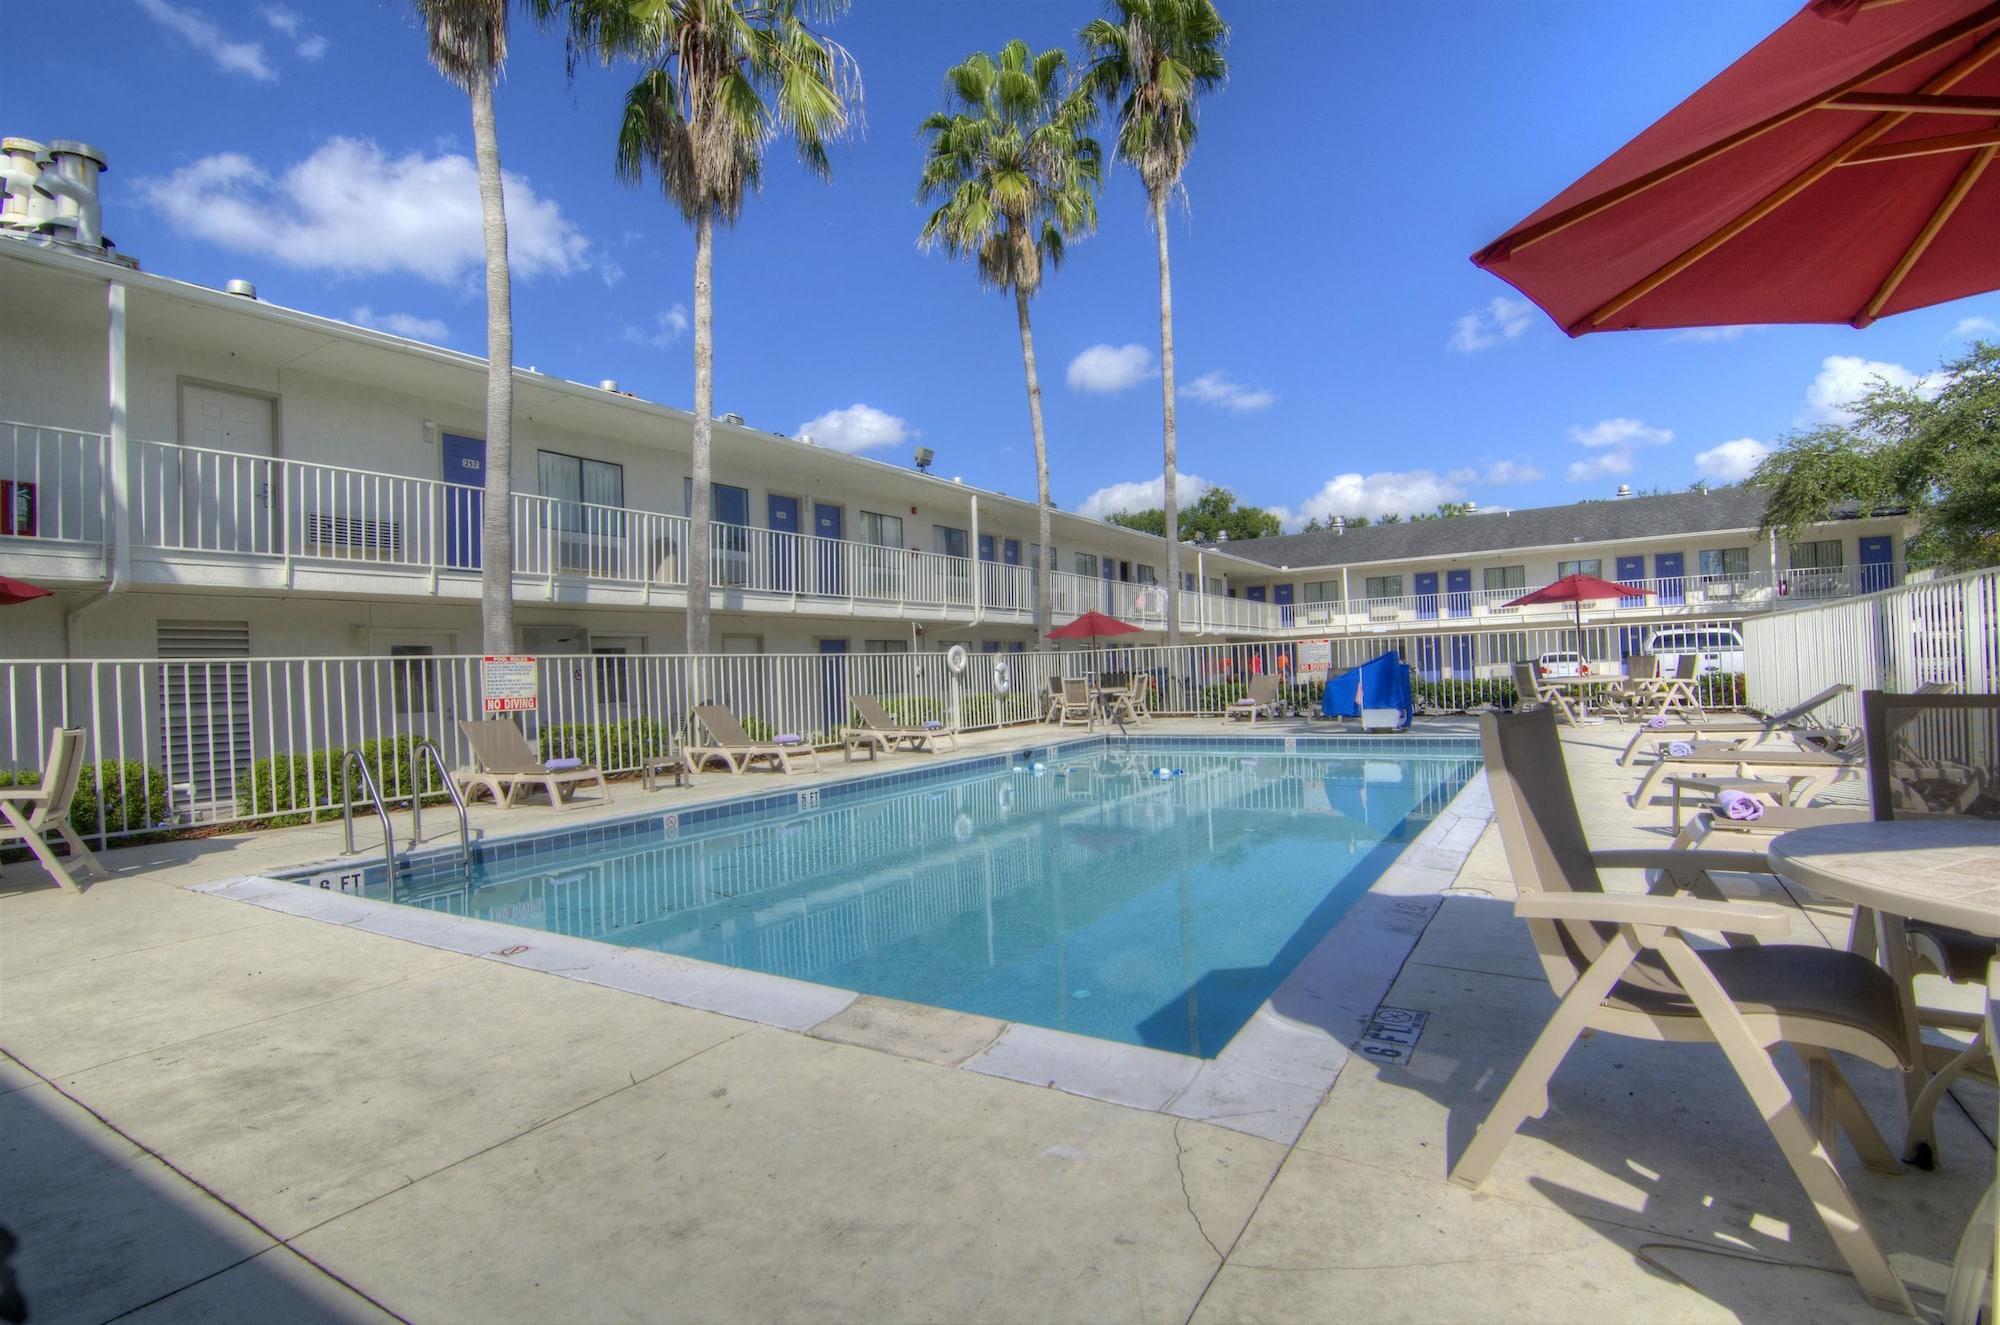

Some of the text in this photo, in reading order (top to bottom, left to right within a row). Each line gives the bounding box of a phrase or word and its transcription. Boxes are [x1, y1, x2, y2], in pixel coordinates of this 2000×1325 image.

[487, 698, 535, 710] NO DIVING
[341, 873, 361, 890] FT
